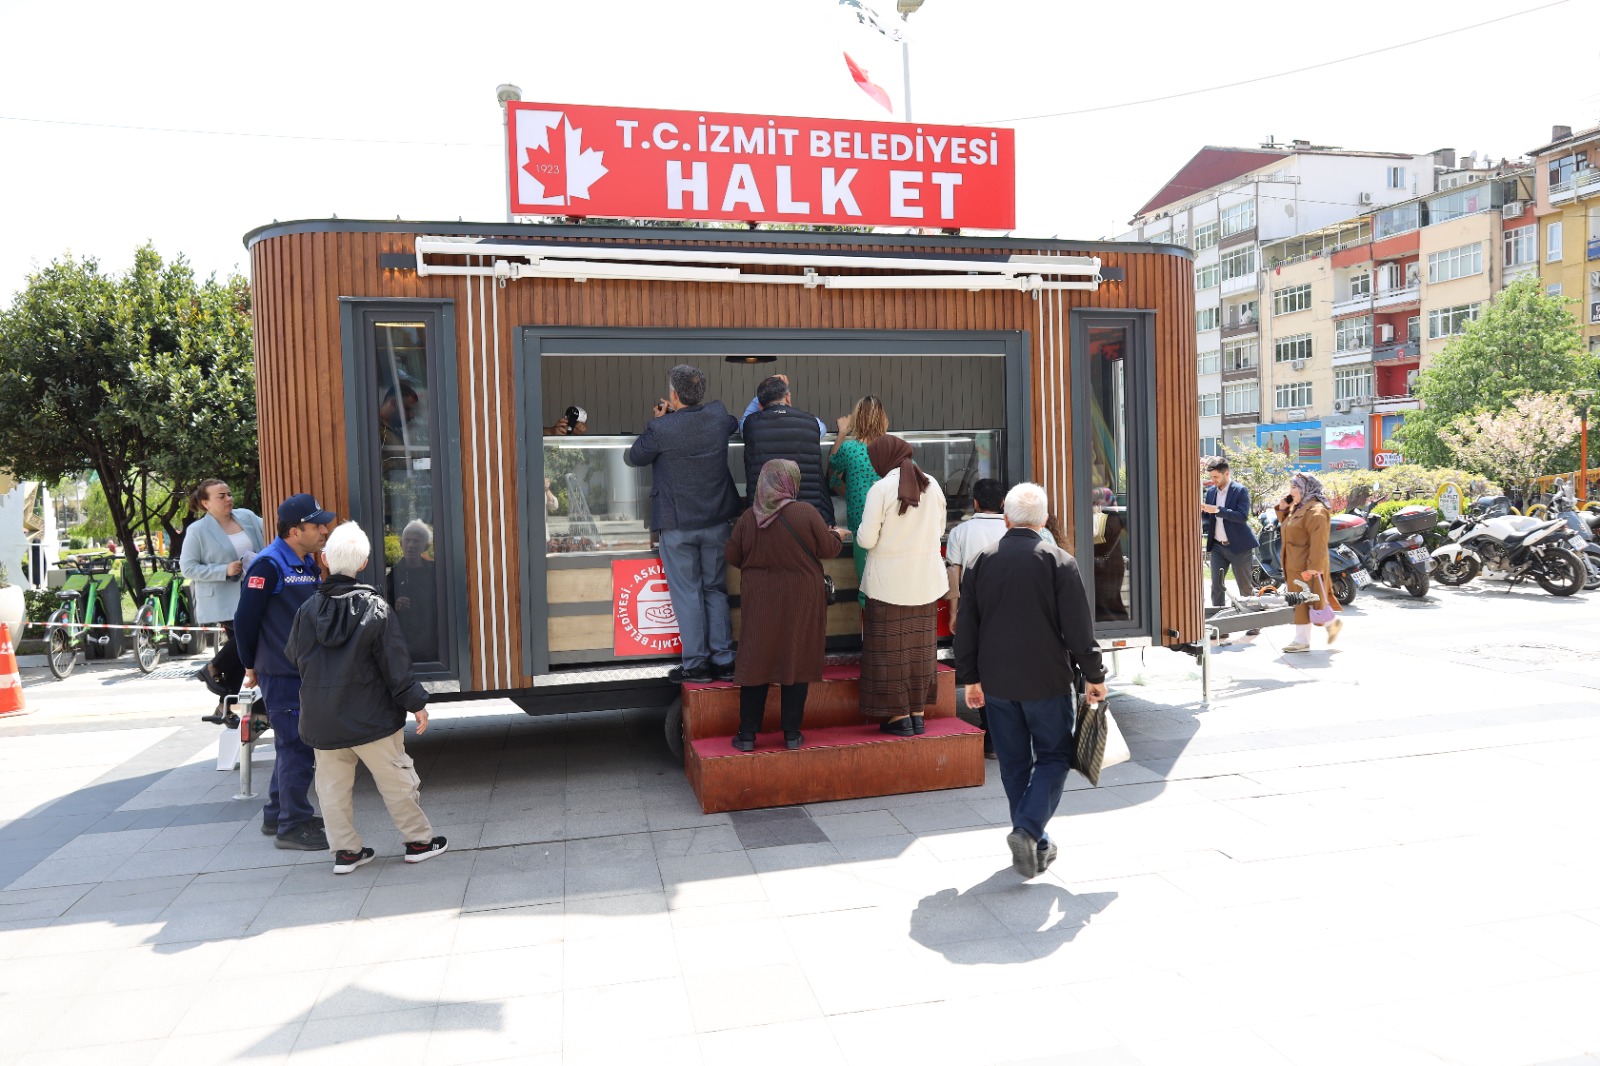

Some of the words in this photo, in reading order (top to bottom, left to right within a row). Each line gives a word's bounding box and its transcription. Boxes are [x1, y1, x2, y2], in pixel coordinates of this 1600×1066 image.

[615, 119, 691, 151] T.C.
[698, 116, 799, 156] İZMİT
[810, 127, 998, 166] BELEDİYESİ
[535, 164, 560, 174] 1923
[666, 160, 863, 216] HALK
[890, 170, 963, 220] ET
[616, 587, 650, 646] BELEDİYESİ
